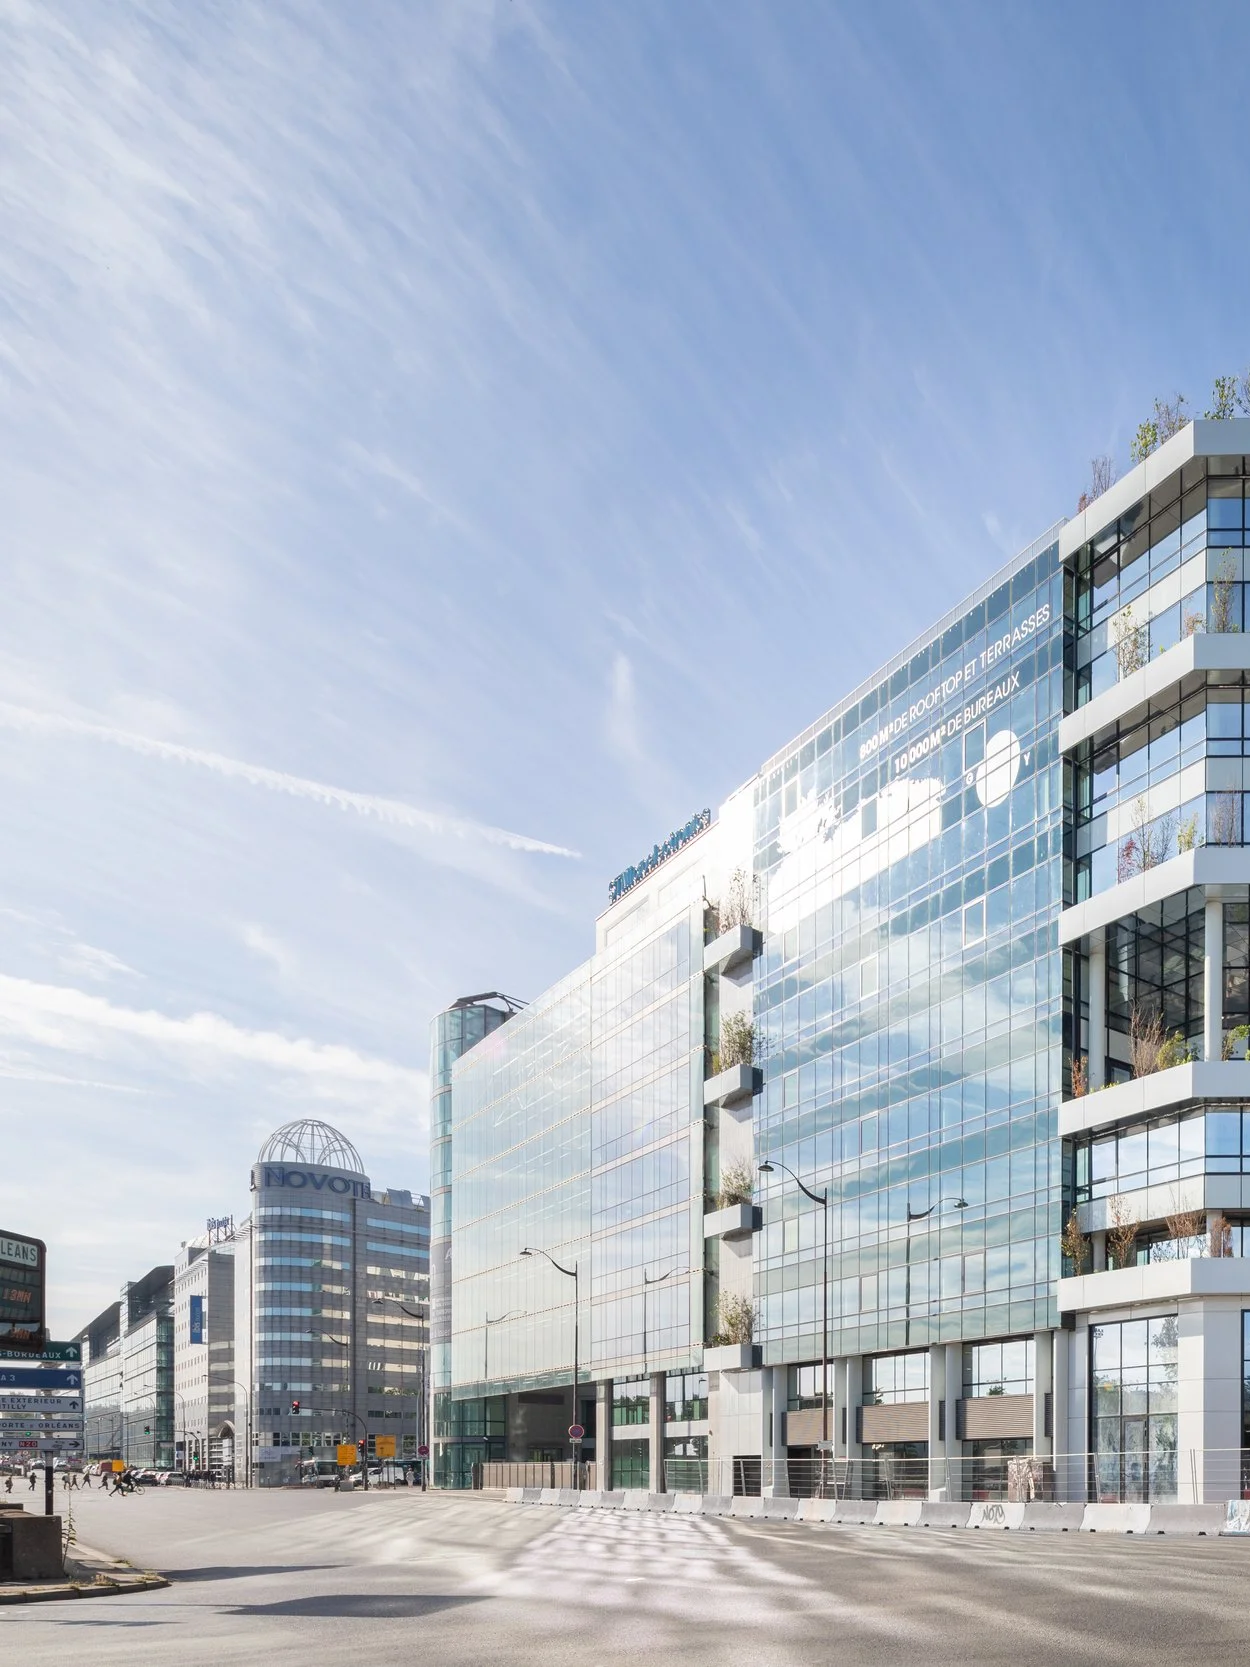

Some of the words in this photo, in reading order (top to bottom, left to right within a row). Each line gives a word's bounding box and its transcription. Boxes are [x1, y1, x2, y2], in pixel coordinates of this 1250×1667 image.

[894, 712, 908, 734] DE
[909, 670, 963, 722] ROOFTOP
[964, 658, 978, 682] ET
[979, 603, 1050, 669] TERRASSES
[894, 753, 908, 774] 10
[909, 737, 930, 763] 000
[947, 712, 962, 737] DE
[964, 670, 1020, 725] BUREAUX
